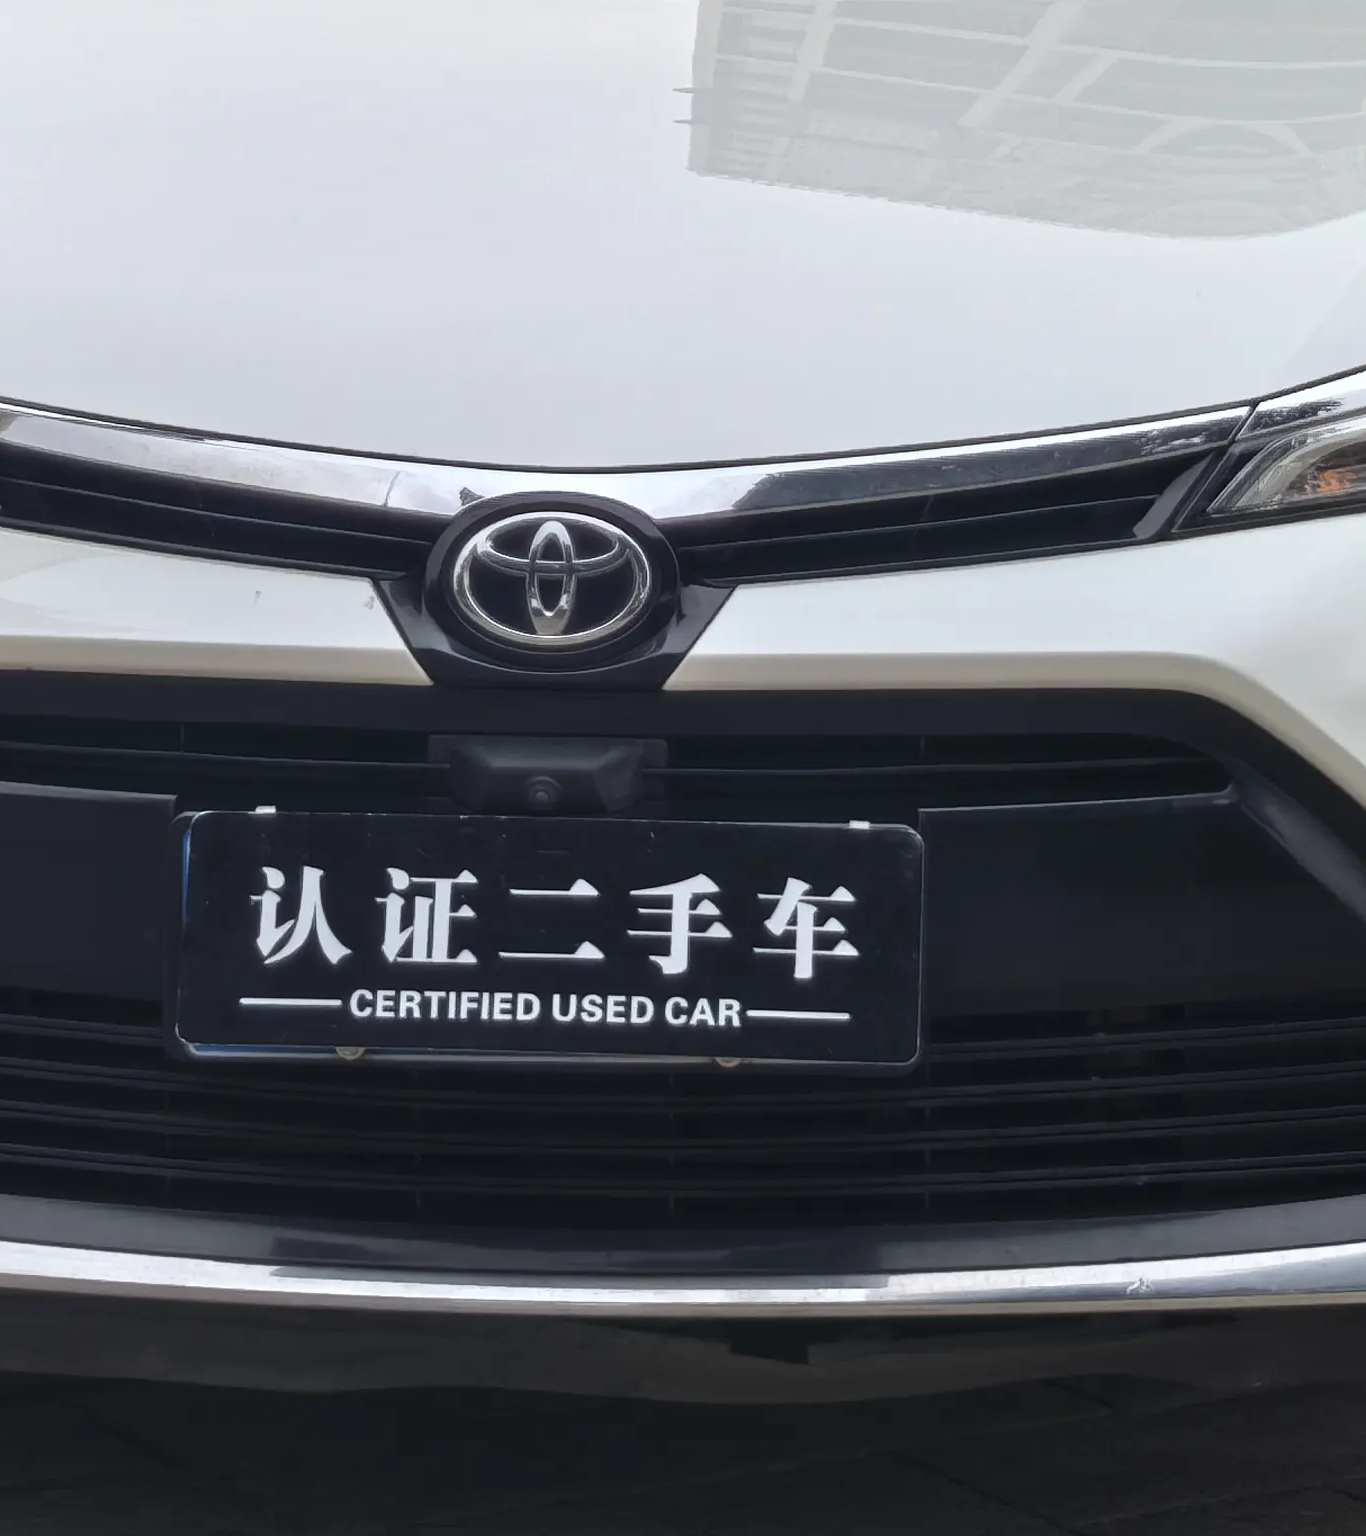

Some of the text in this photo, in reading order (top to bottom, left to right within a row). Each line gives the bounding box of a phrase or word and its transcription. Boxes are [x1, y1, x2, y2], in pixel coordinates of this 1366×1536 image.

[249, 865, 860, 981] 认证二手车
[349, 988, 742, 1028] CERTIFIED USED CAR
